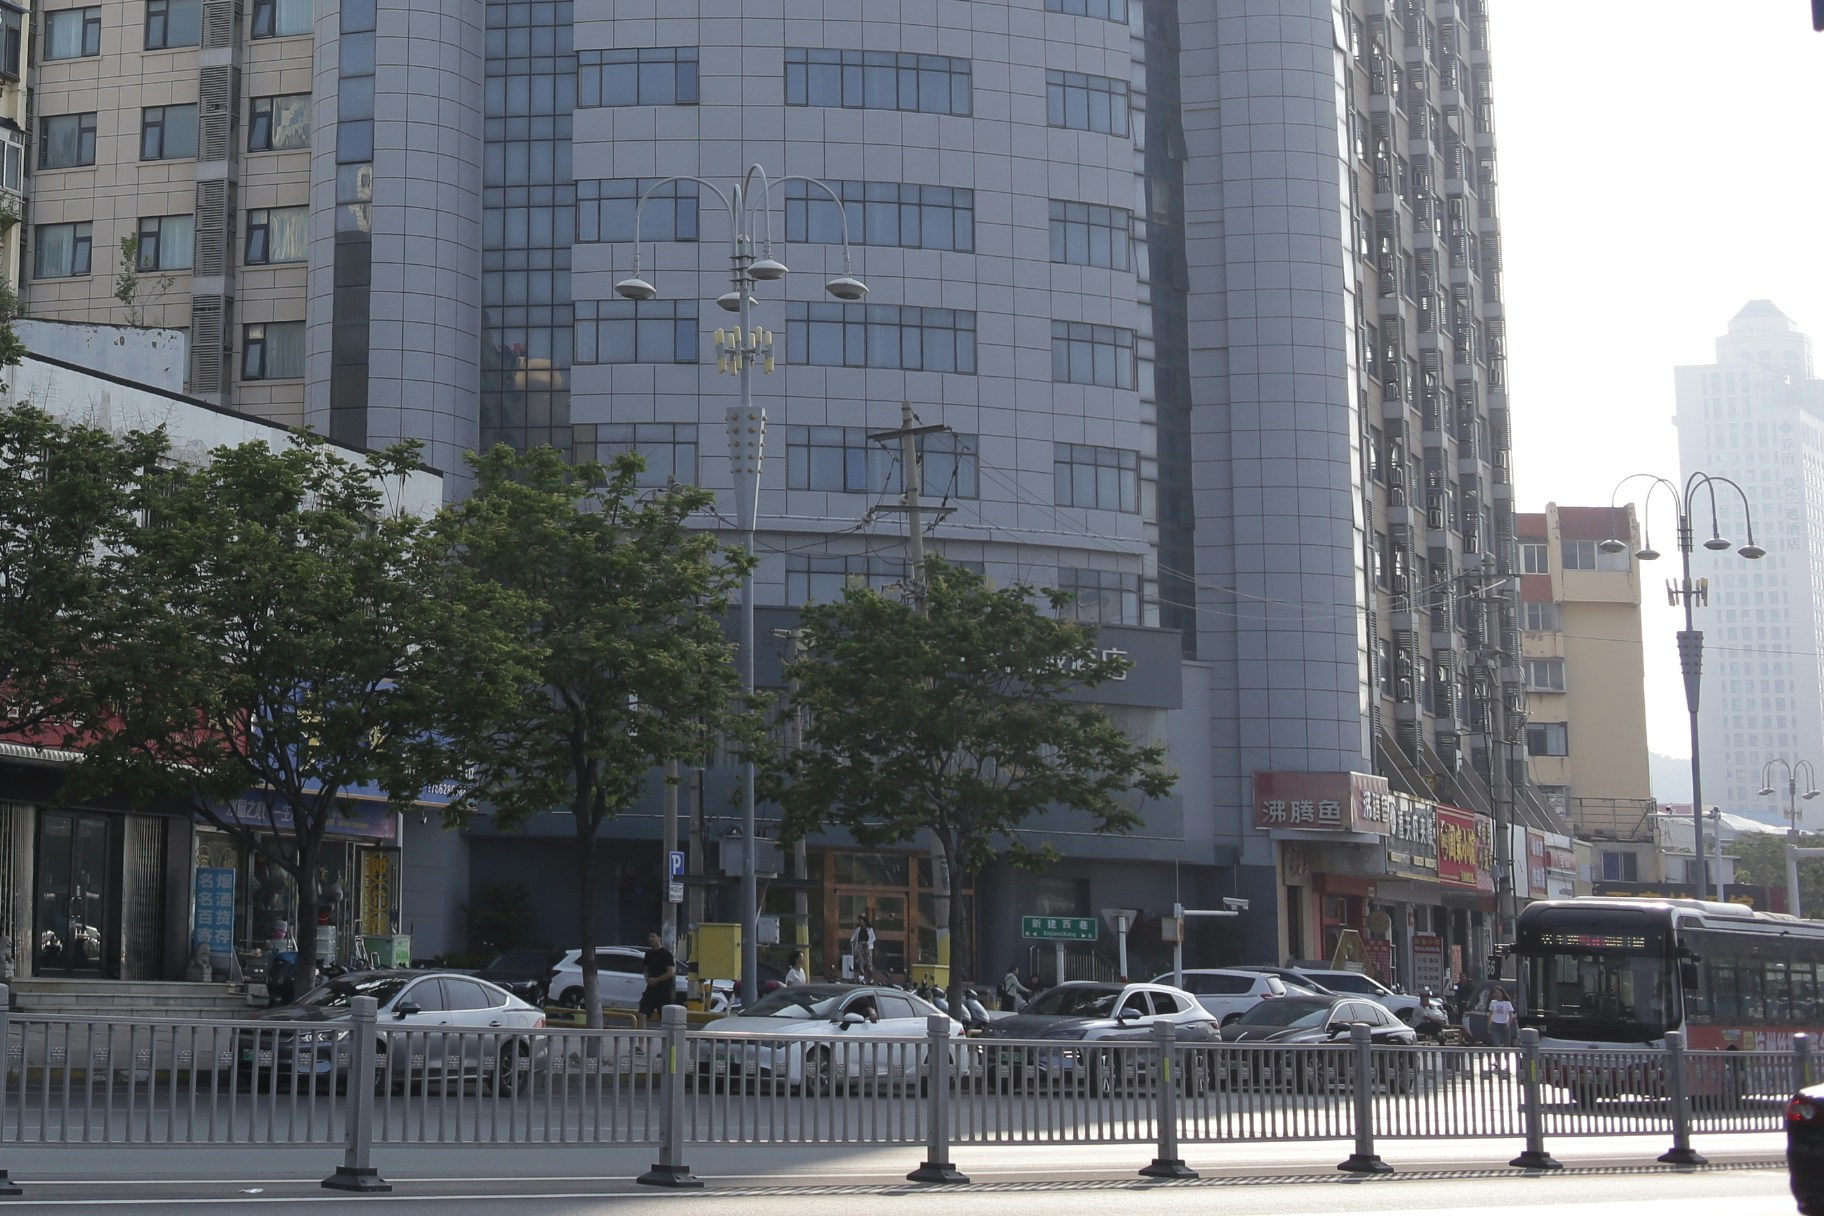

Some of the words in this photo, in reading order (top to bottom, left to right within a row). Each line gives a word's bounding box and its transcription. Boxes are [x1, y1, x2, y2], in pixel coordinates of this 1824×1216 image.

[1262, 799, 1341, 824] 沸腾鱼
[1032, 918, 1088, 930] 新建西巷
